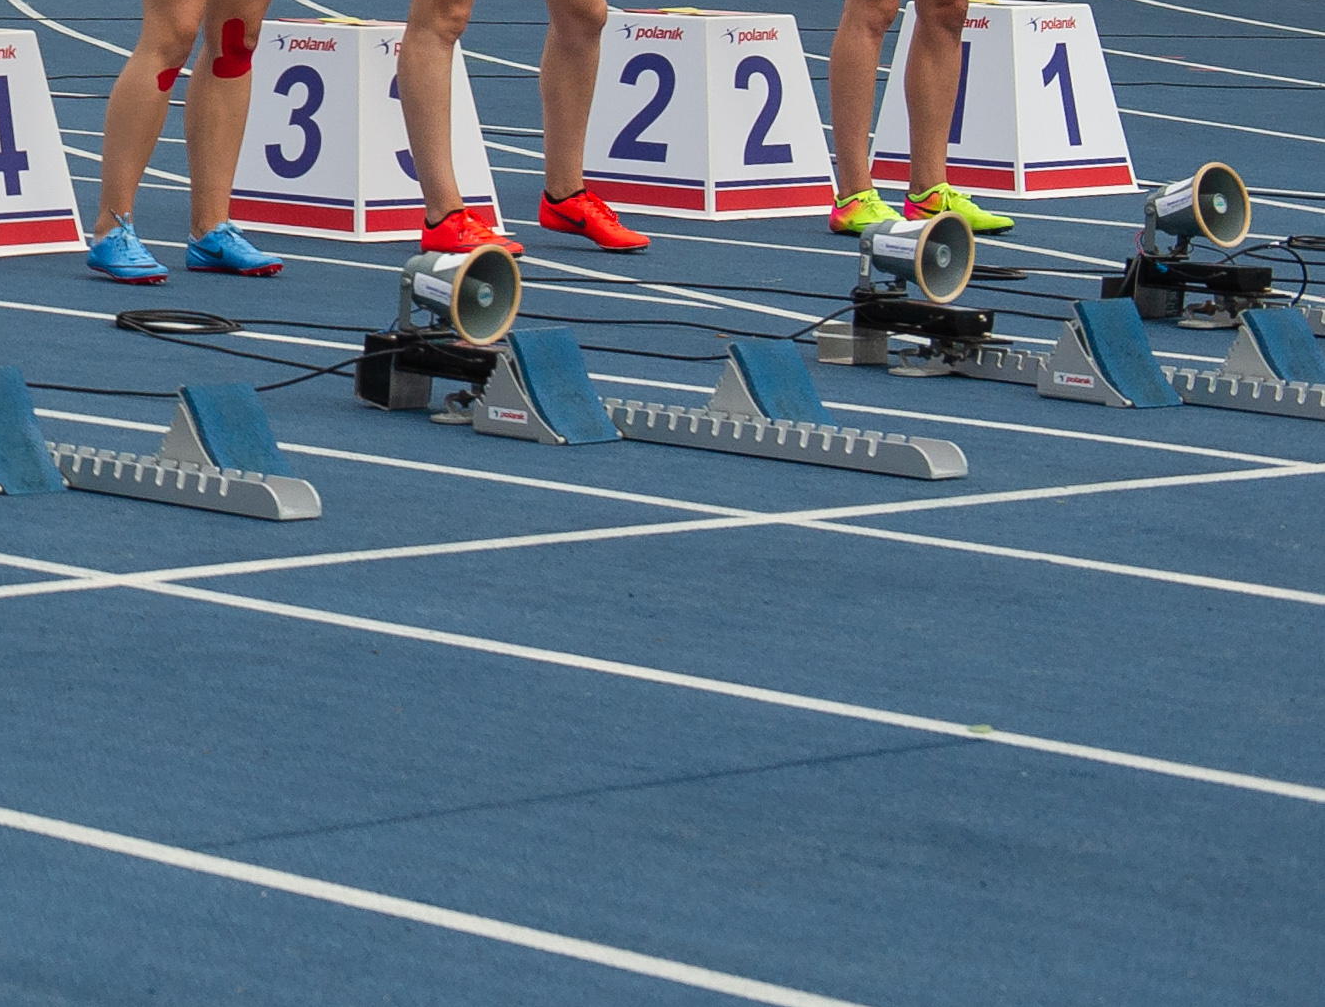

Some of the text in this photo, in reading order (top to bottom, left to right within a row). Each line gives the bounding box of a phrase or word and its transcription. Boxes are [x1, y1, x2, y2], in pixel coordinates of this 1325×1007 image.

[963, 15, 990, 29] anik
[1040, 16, 1077, 33] polanik
[635, 25, 684, 42] polanik
[738, 27, 778, 45] polanik
[288, 35, 338, 53] polanik
[1042, 42, 1082, 147] 1
[608, 52, 676, 163] 2
[734, 55, 793, 166] 2
[265, 65, 324, 179] 3
